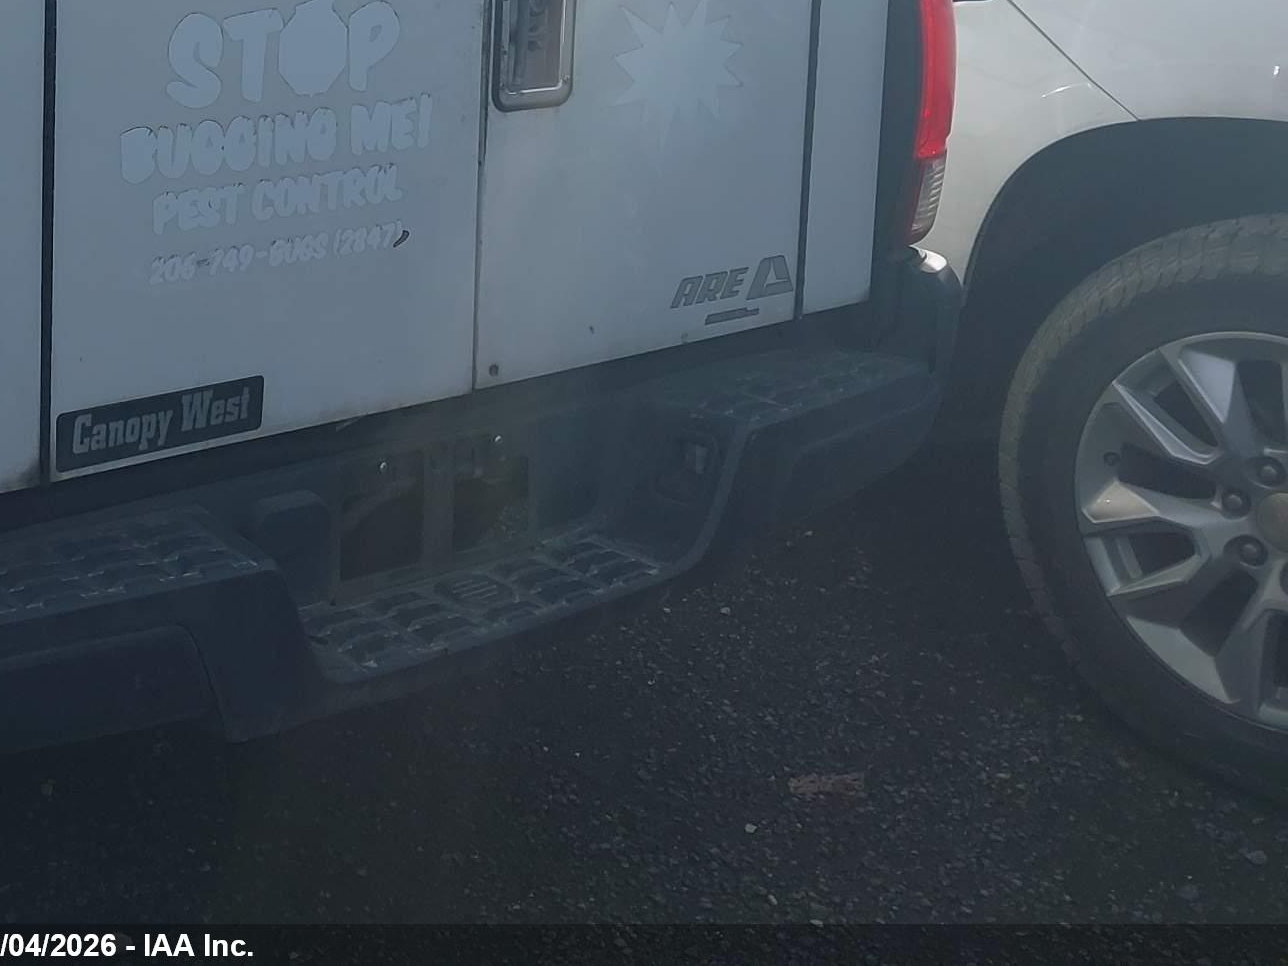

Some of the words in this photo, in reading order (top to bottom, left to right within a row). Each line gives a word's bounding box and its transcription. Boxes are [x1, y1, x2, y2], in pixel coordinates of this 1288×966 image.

[120, 106, 338, 184] BUGGING
[350, 92, 433, 156] ME!
[152, 183, 246, 235] PEST
[252, 162, 404, 221] CONTROL
[670, 266, 750, 309] ARE
[72, 408, 174, 455] Canopy
[180, 386, 251, 432] West
